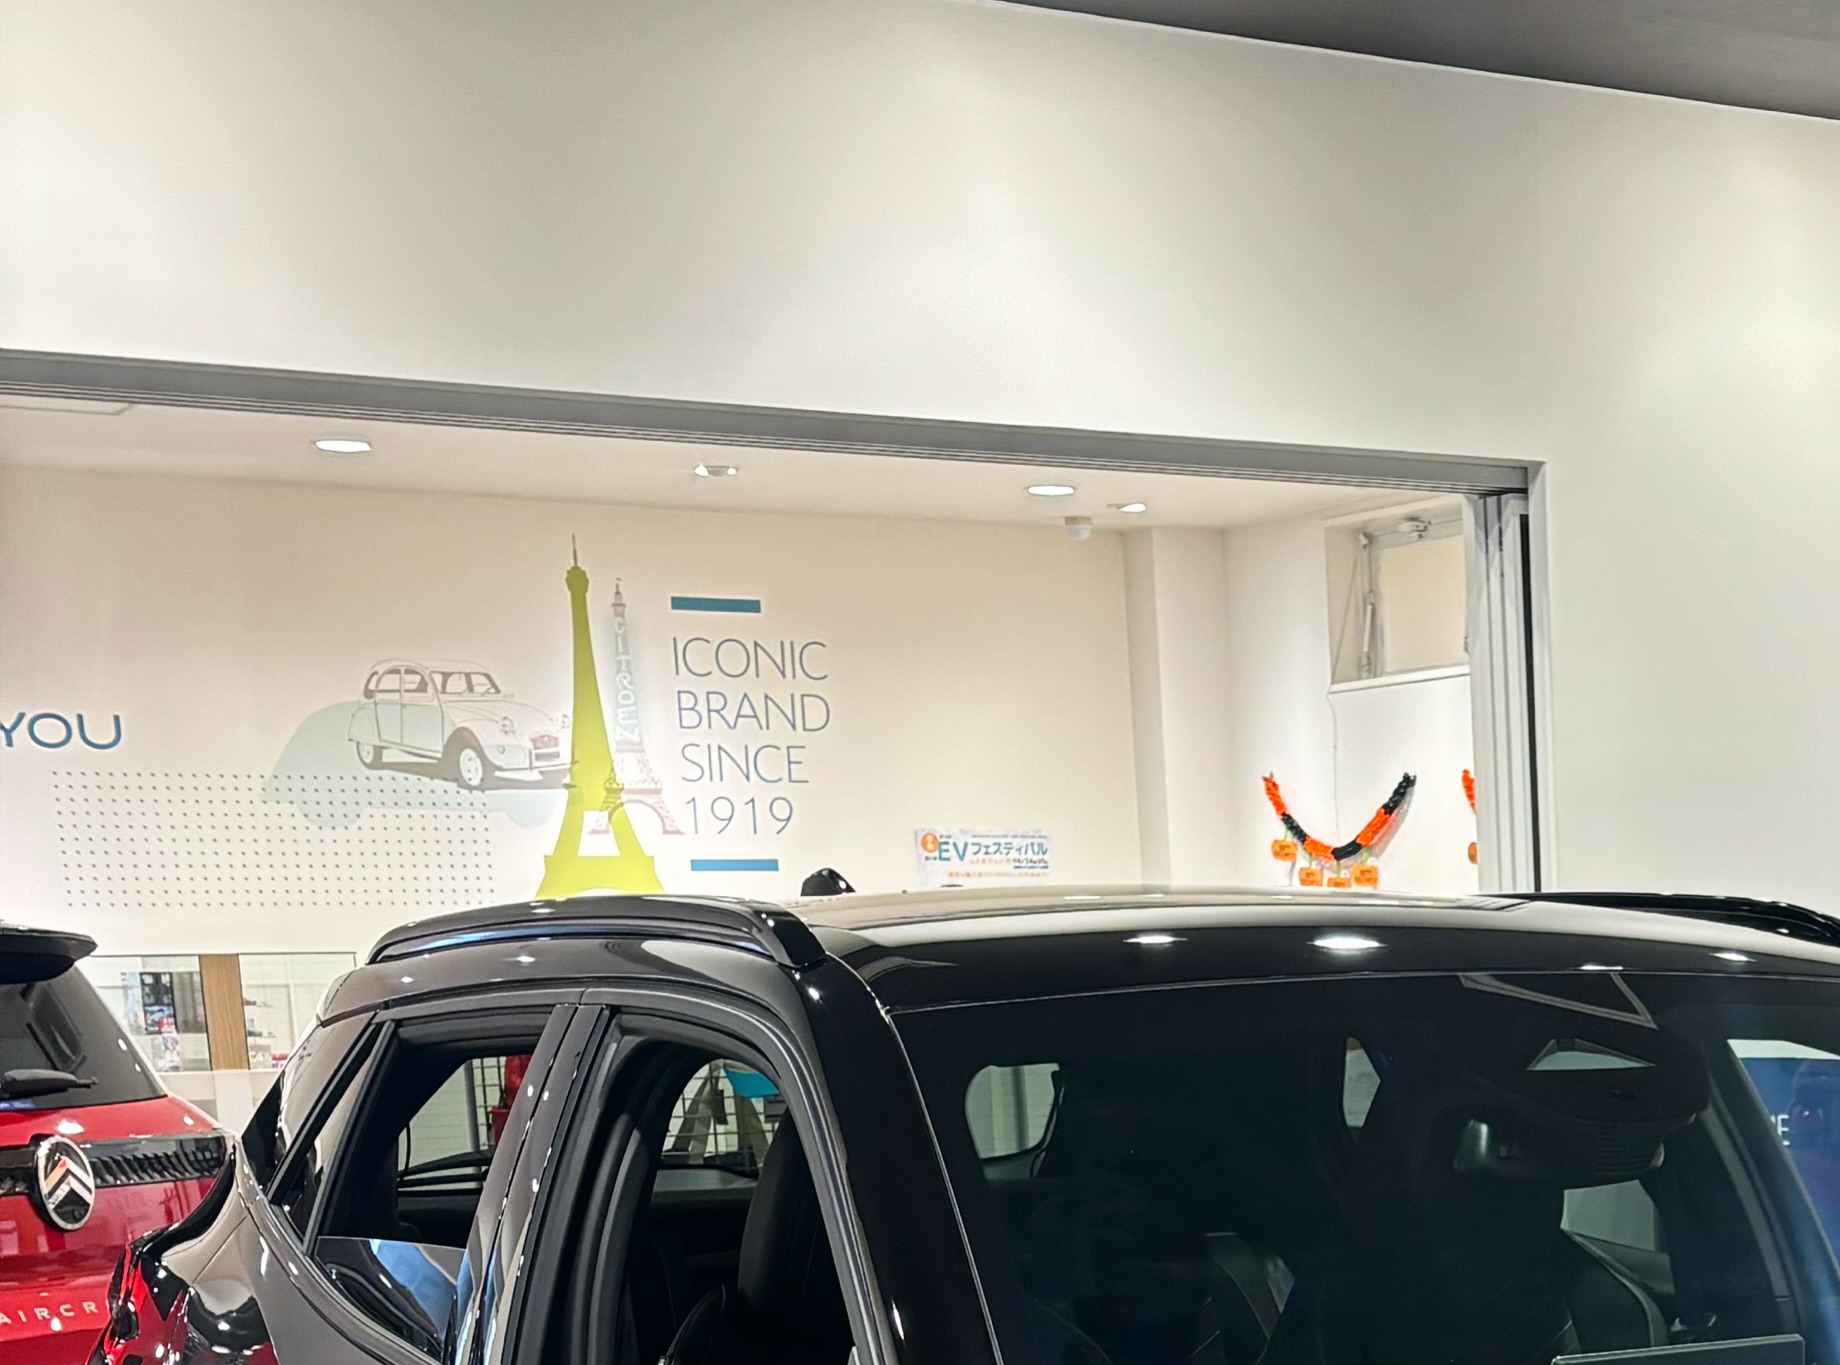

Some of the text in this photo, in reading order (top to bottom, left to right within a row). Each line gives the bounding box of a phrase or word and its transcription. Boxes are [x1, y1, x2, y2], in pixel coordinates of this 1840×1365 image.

[614, 616, 641, 742] CITROEN
[673, 636, 830, 682] ICONIC
[0, 711, 123, 751] YOU
[677, 691, 831, 733] BRAND
[682, 744, 809, 785] SINCE
[685, 795, 794, 836] 1919
[938, 841, 1048, 862] EVフェスティバル
[0, 1301, 109, 1324] AIRCR
